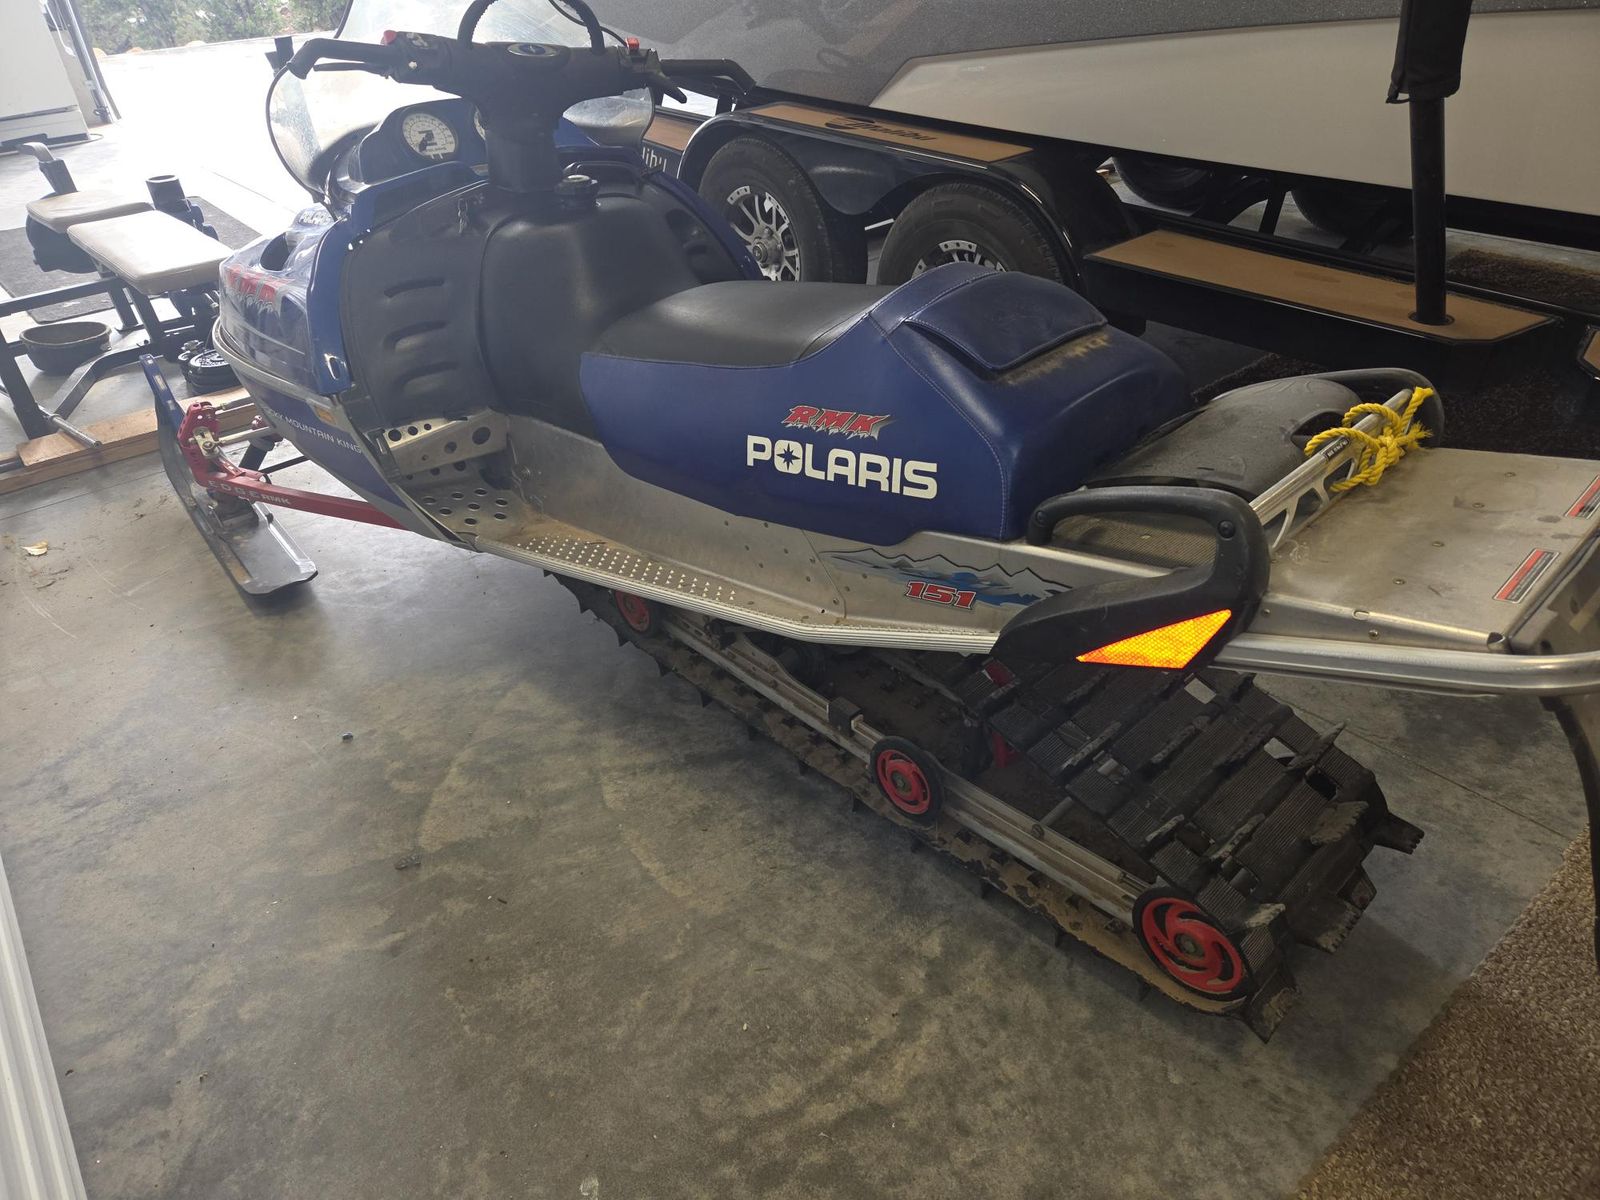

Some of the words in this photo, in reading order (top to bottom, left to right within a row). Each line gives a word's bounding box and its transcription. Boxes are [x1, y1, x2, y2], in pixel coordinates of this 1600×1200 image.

[285, 416, 334, 442] MOUNTAIN
[336, 438, 362, 454] KING
[781, 405, 891, 438] RMK
[746, 434, 938, 500] POLARIS
[905, 580, 977, 610] 151
